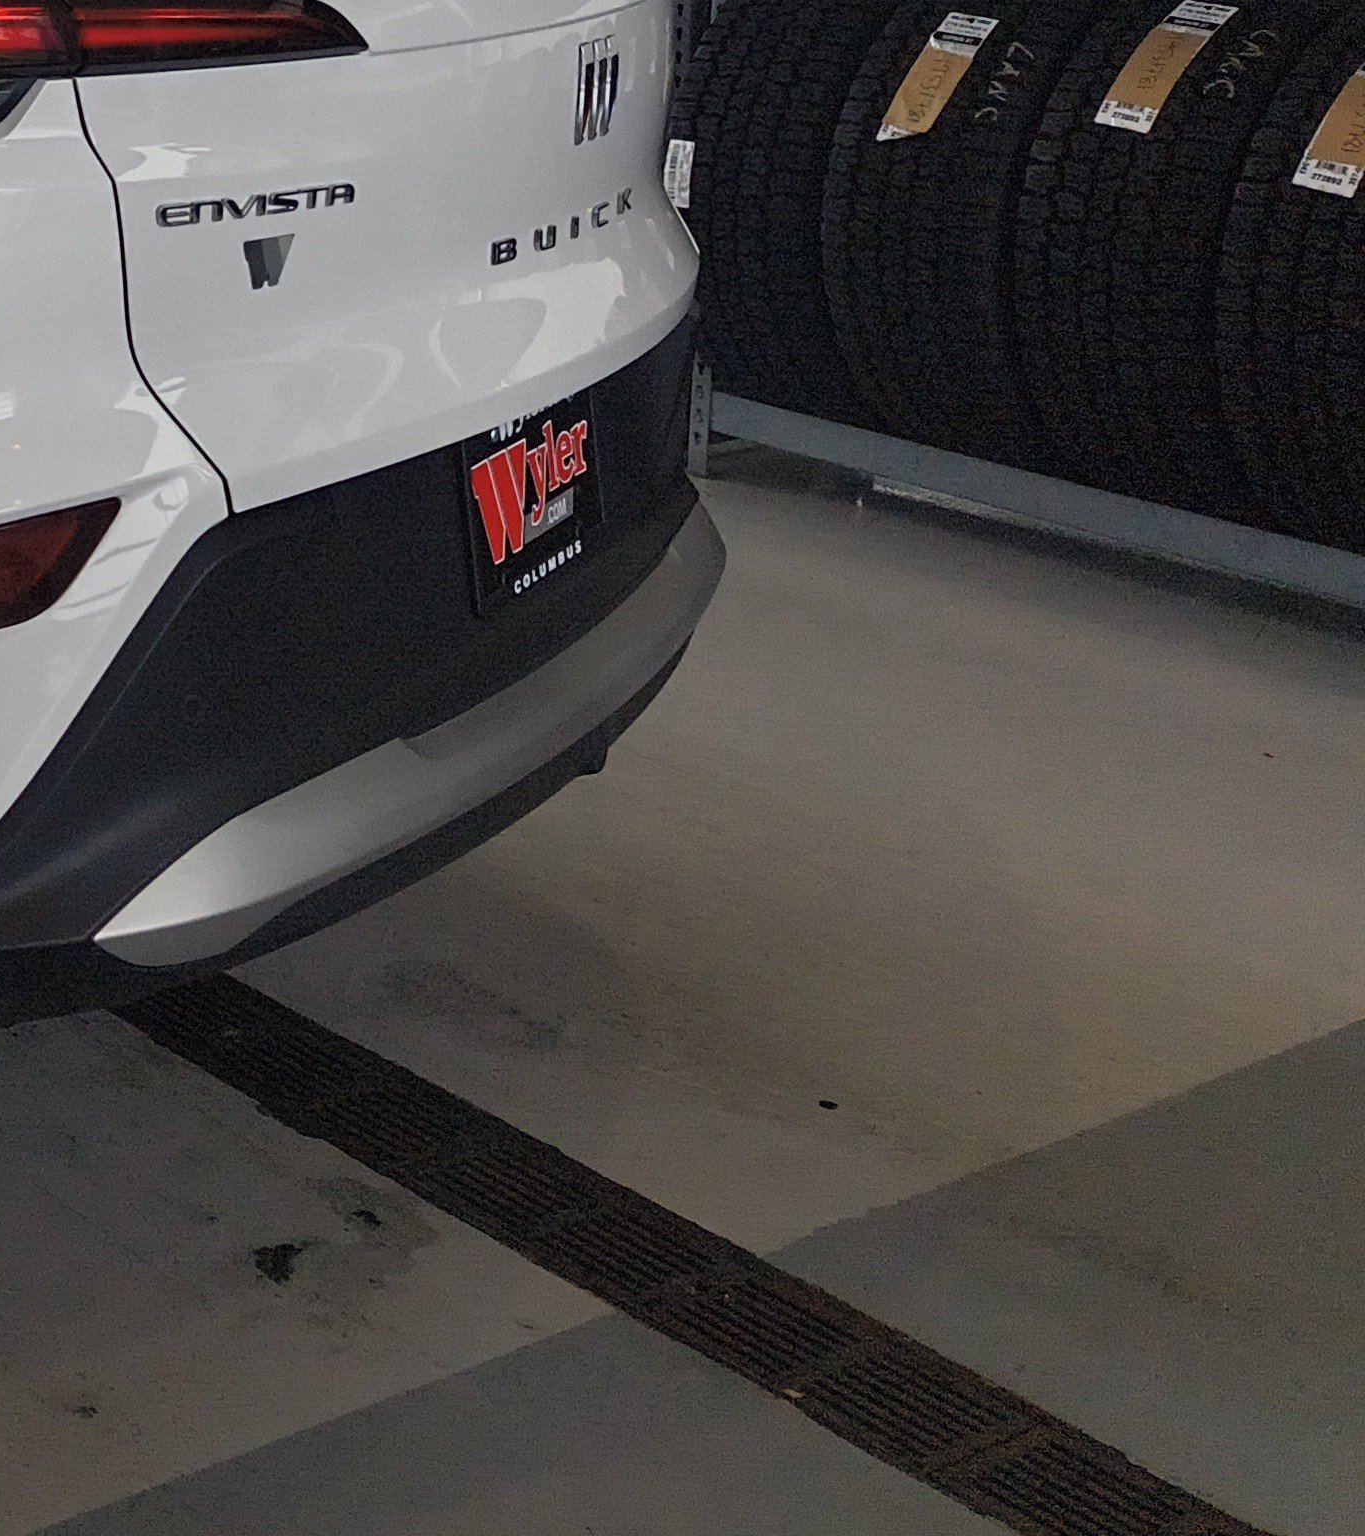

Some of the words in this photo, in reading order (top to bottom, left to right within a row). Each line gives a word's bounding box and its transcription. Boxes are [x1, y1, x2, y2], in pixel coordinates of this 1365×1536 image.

[155, 182, 356, 228] ENVISTA
[489, 187, 633, 266] BUICK
[470, 419, 588, 565] Wyler
[513, 539, 583, 594] COLUMBUS
